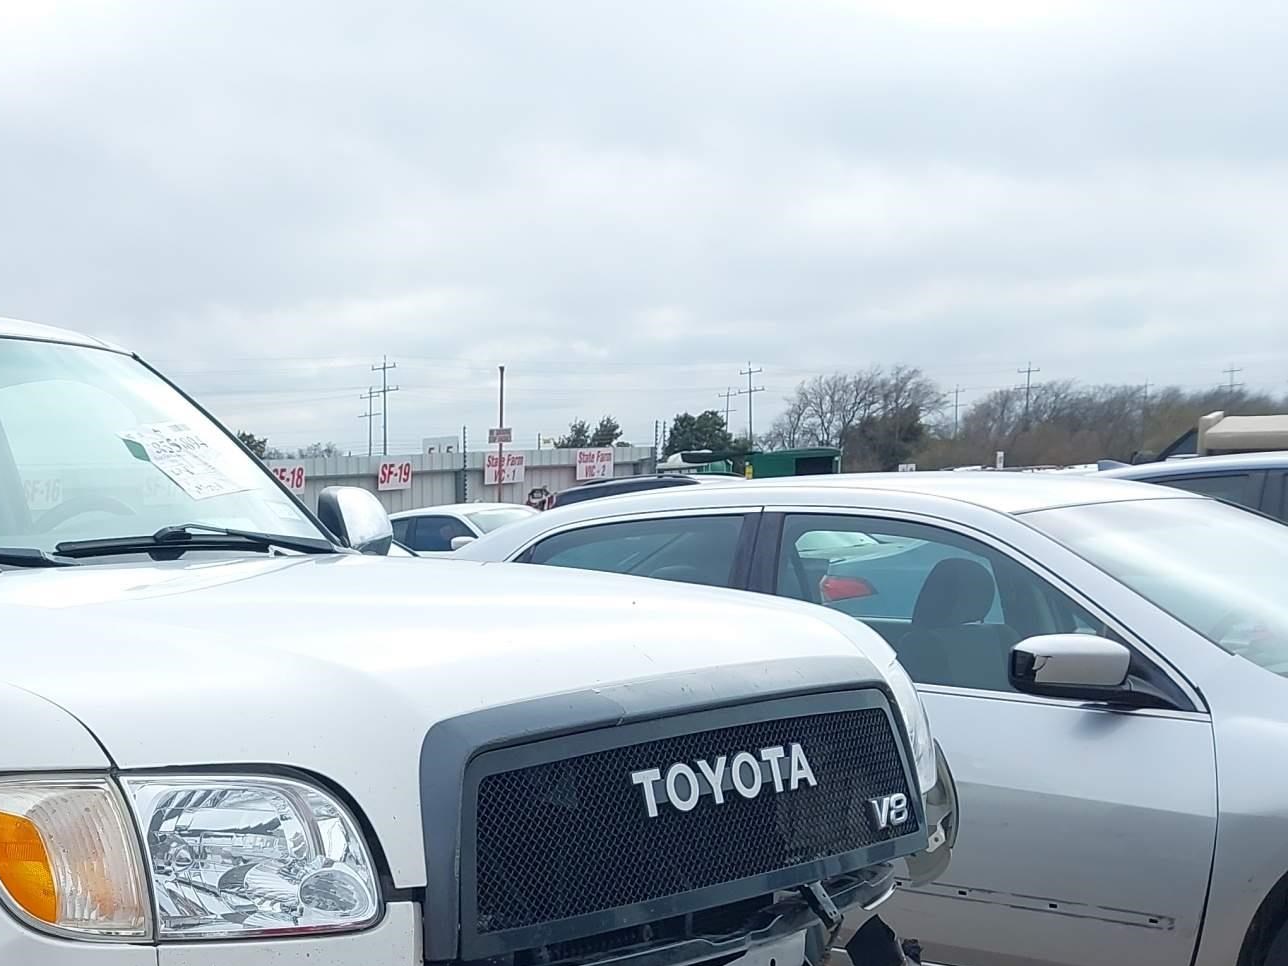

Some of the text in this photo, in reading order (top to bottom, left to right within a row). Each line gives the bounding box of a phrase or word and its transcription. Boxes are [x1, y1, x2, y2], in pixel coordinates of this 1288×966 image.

[487, 455, 505, 468] Stae
[380, 463, 410, 484] SF-19
[493, 469, 506, 482] VC
[632, 743, 817, 817] TOYOTA
[871, 793, 908, 827] V8
